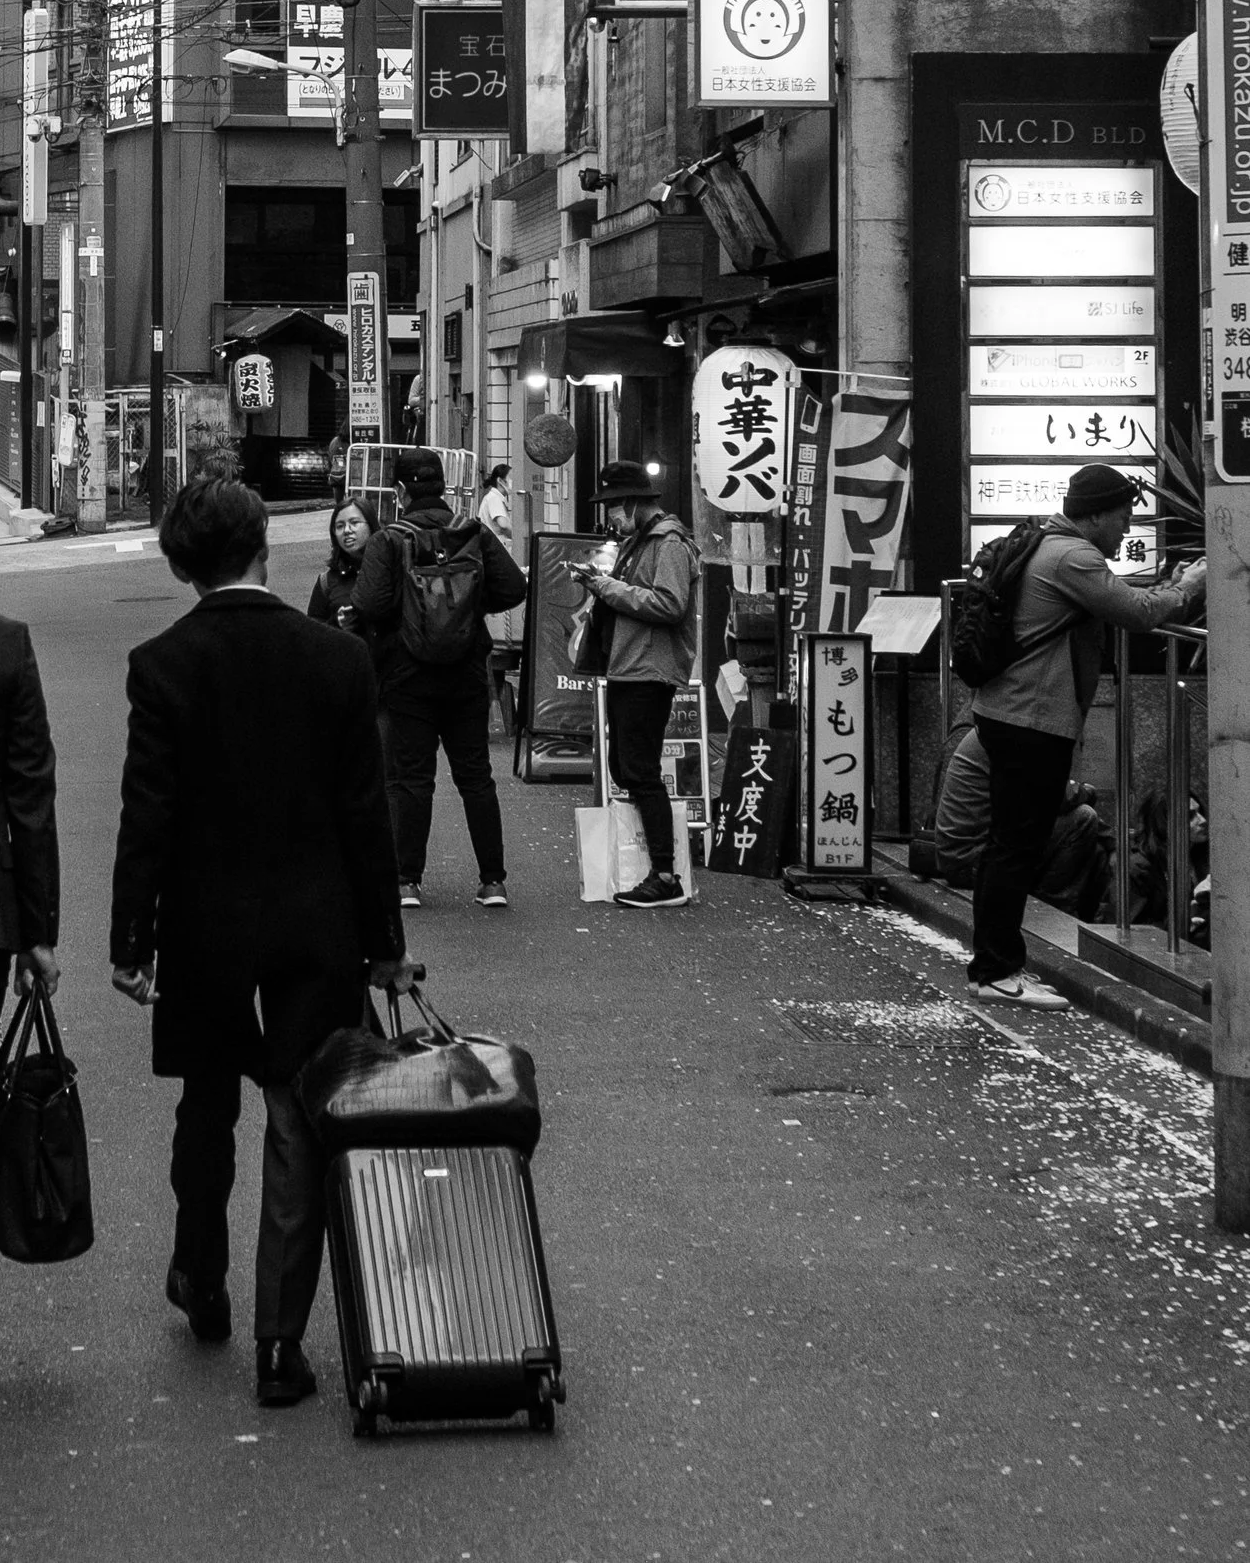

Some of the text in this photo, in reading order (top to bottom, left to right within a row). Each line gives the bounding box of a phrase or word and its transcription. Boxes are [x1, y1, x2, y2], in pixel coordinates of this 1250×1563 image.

[458, 34, 506, 57] 宝石
[429, 68, 507, 99] まつみ
[712, 77, 818, 92] 日本女性支援協会
[977, 119, 1146, 144] M.C.D BLD
[1017, 190, 1144, 205] 日本女性支援協会
[1122, 301, 1144, 315] Life
[1134, 350, 1149, 361] 2F
[238, 361, 263, 408] 炭火焼
[1020, 376, 1079, 388] GLOBAL
[1082, 375, 1138, 388] WORKS
[717, 360, 779, 501] 中華ソバ
[1046, 412, 1136, 450] いまり
[828, 393, 911, 633] スマホ
[557, 674, 582, 691] Bar
[818, 646, 860, 827] 博多もつ鍋
[733, 738, 774, 866] 支度中
[825, 853, 855, 865] B1F
